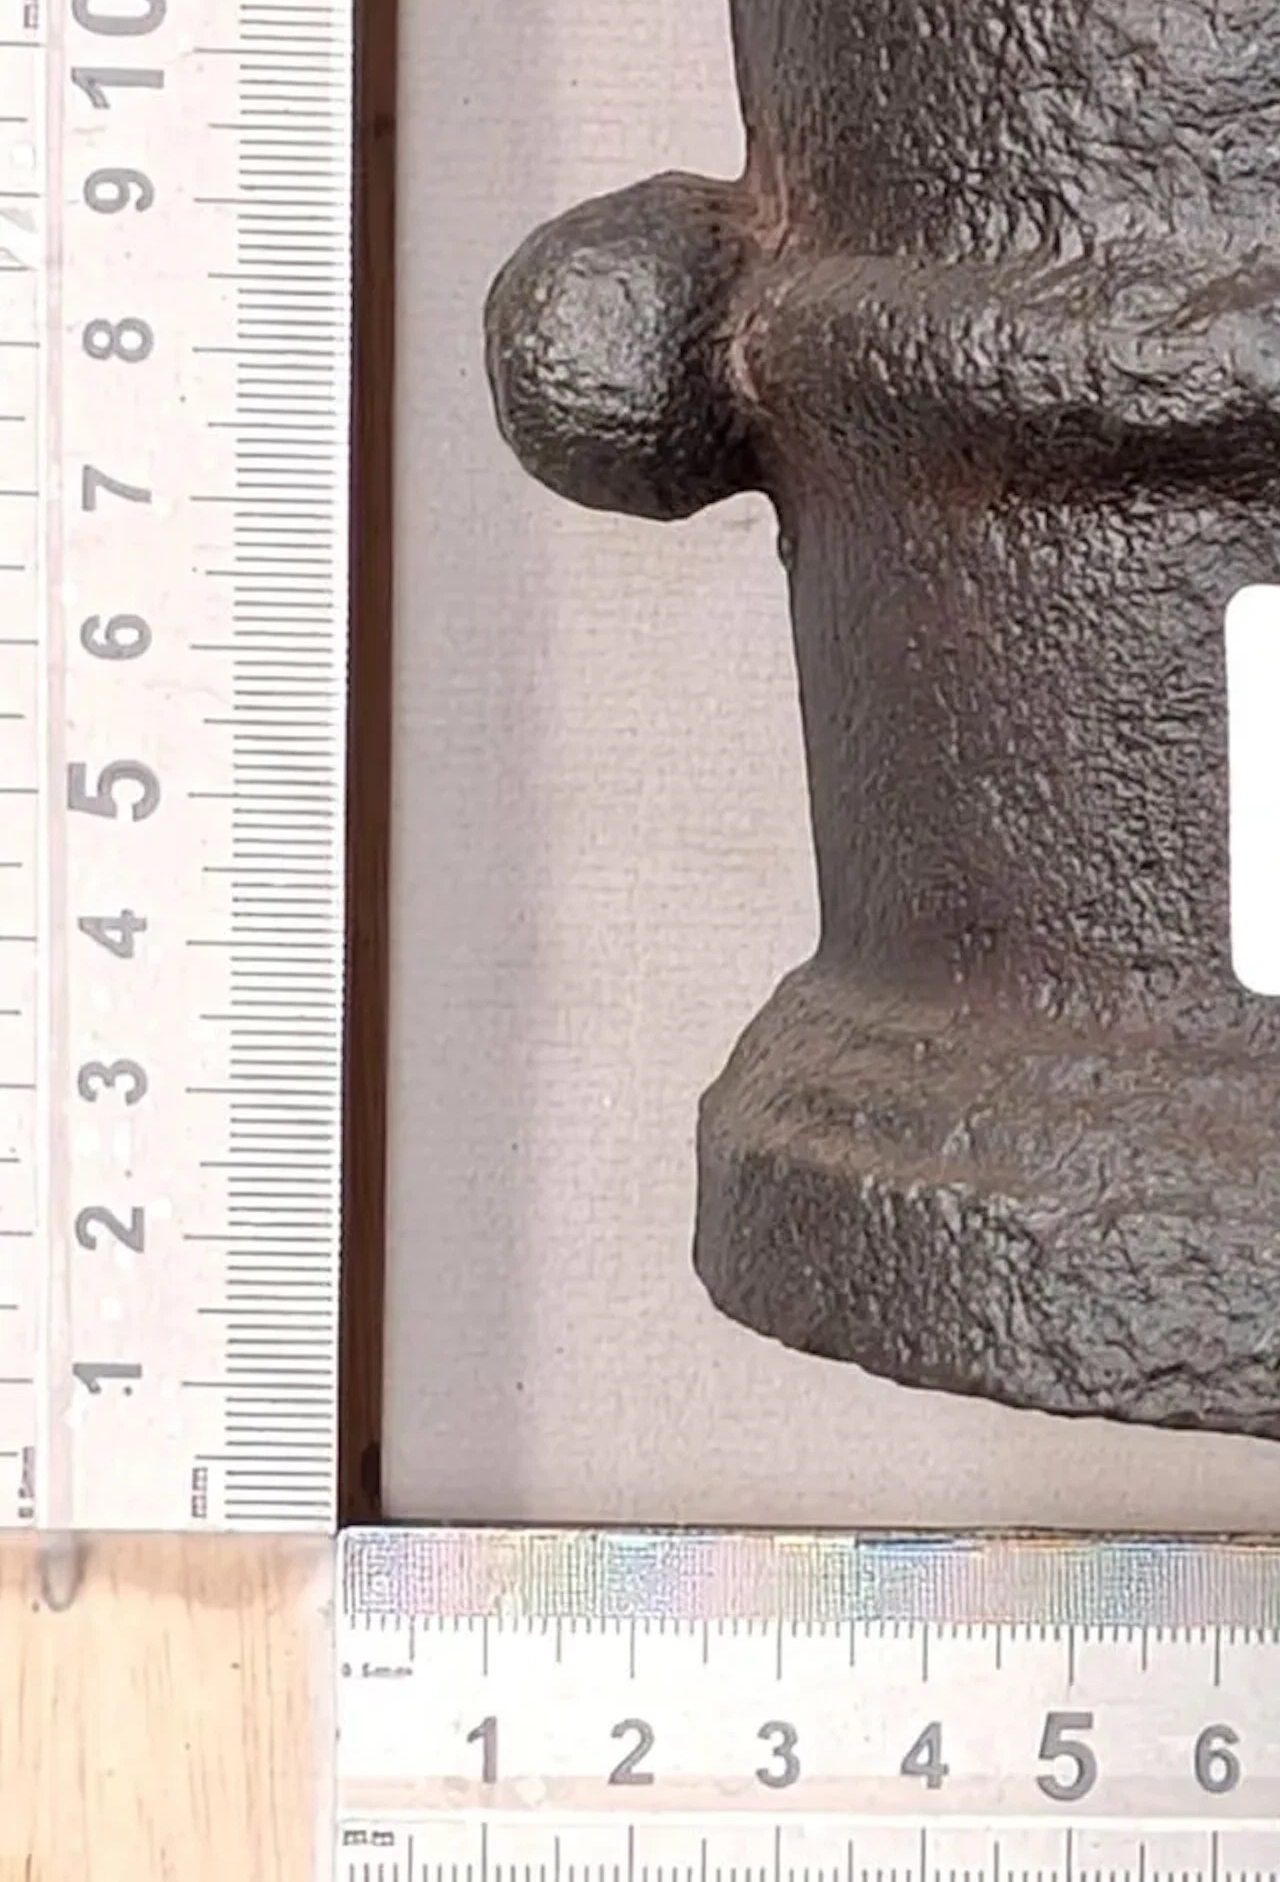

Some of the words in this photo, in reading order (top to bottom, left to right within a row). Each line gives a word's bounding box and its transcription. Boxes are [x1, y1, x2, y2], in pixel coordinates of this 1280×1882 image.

[82, 167, 155, 215] 9
[82, 317, 155, 364] 8
[82, 463, 153, 513] 7
[79, 613, 153, 662] 6
[67, 759, 161, 823] 5
[77, 908, 148, 960] 4
[76, 1058, 148, 1107] 3
[75, 1205, 146, 1255] 2
[72, 1361, 143, 1396] 1
[465, 1715, 498, 1784] 1
[606, 1717, 656, 1788] 2
[754, 1719, 801, 1791] 3
[898, 1720, 951, 1791] 4
[1034, 1710, 1098, 1804] 5
[1193, 1723, 1241, 1796] 6
